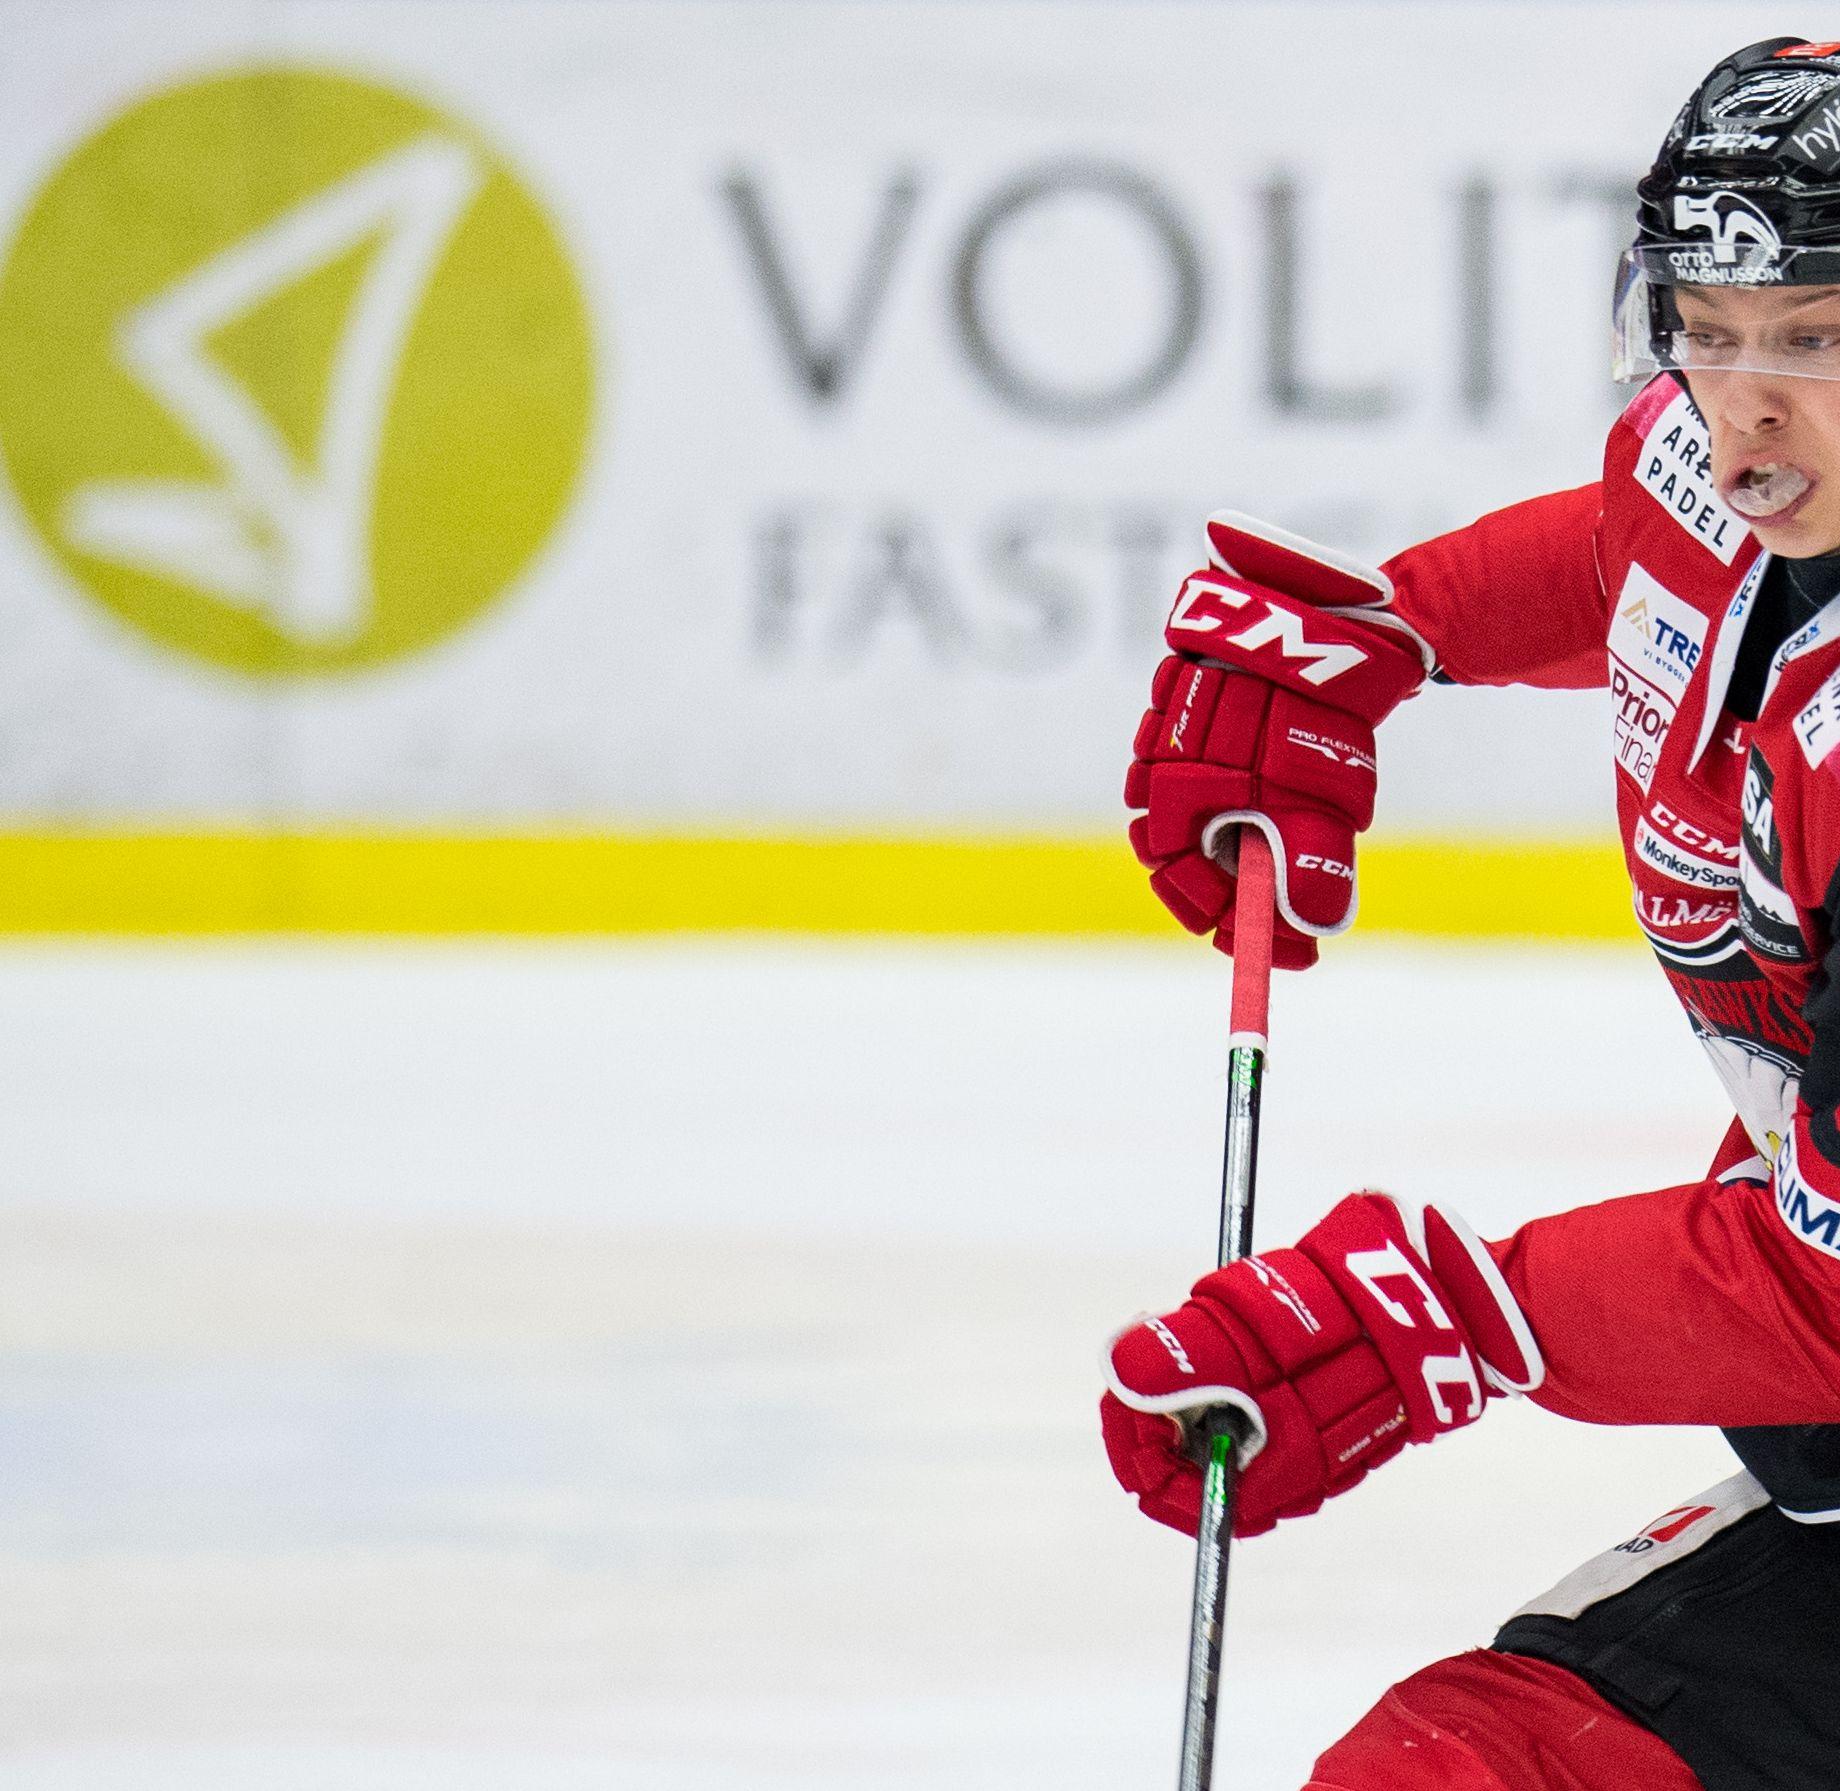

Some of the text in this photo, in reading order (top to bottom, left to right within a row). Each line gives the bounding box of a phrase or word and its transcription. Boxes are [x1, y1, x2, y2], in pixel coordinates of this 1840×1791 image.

[1668, 251, 1714, 268] OTTO
[1674, 266, 1784, 284] MAGNUSSON
[1662, 425, 1714, 488] ARE
[1647, 456, 1728, 548] PADEL
[1185, 669, 1203, 708] PRO
[1289, 727, 1318, 742] PRO
[1650, 800, 1741, 860] CCM
